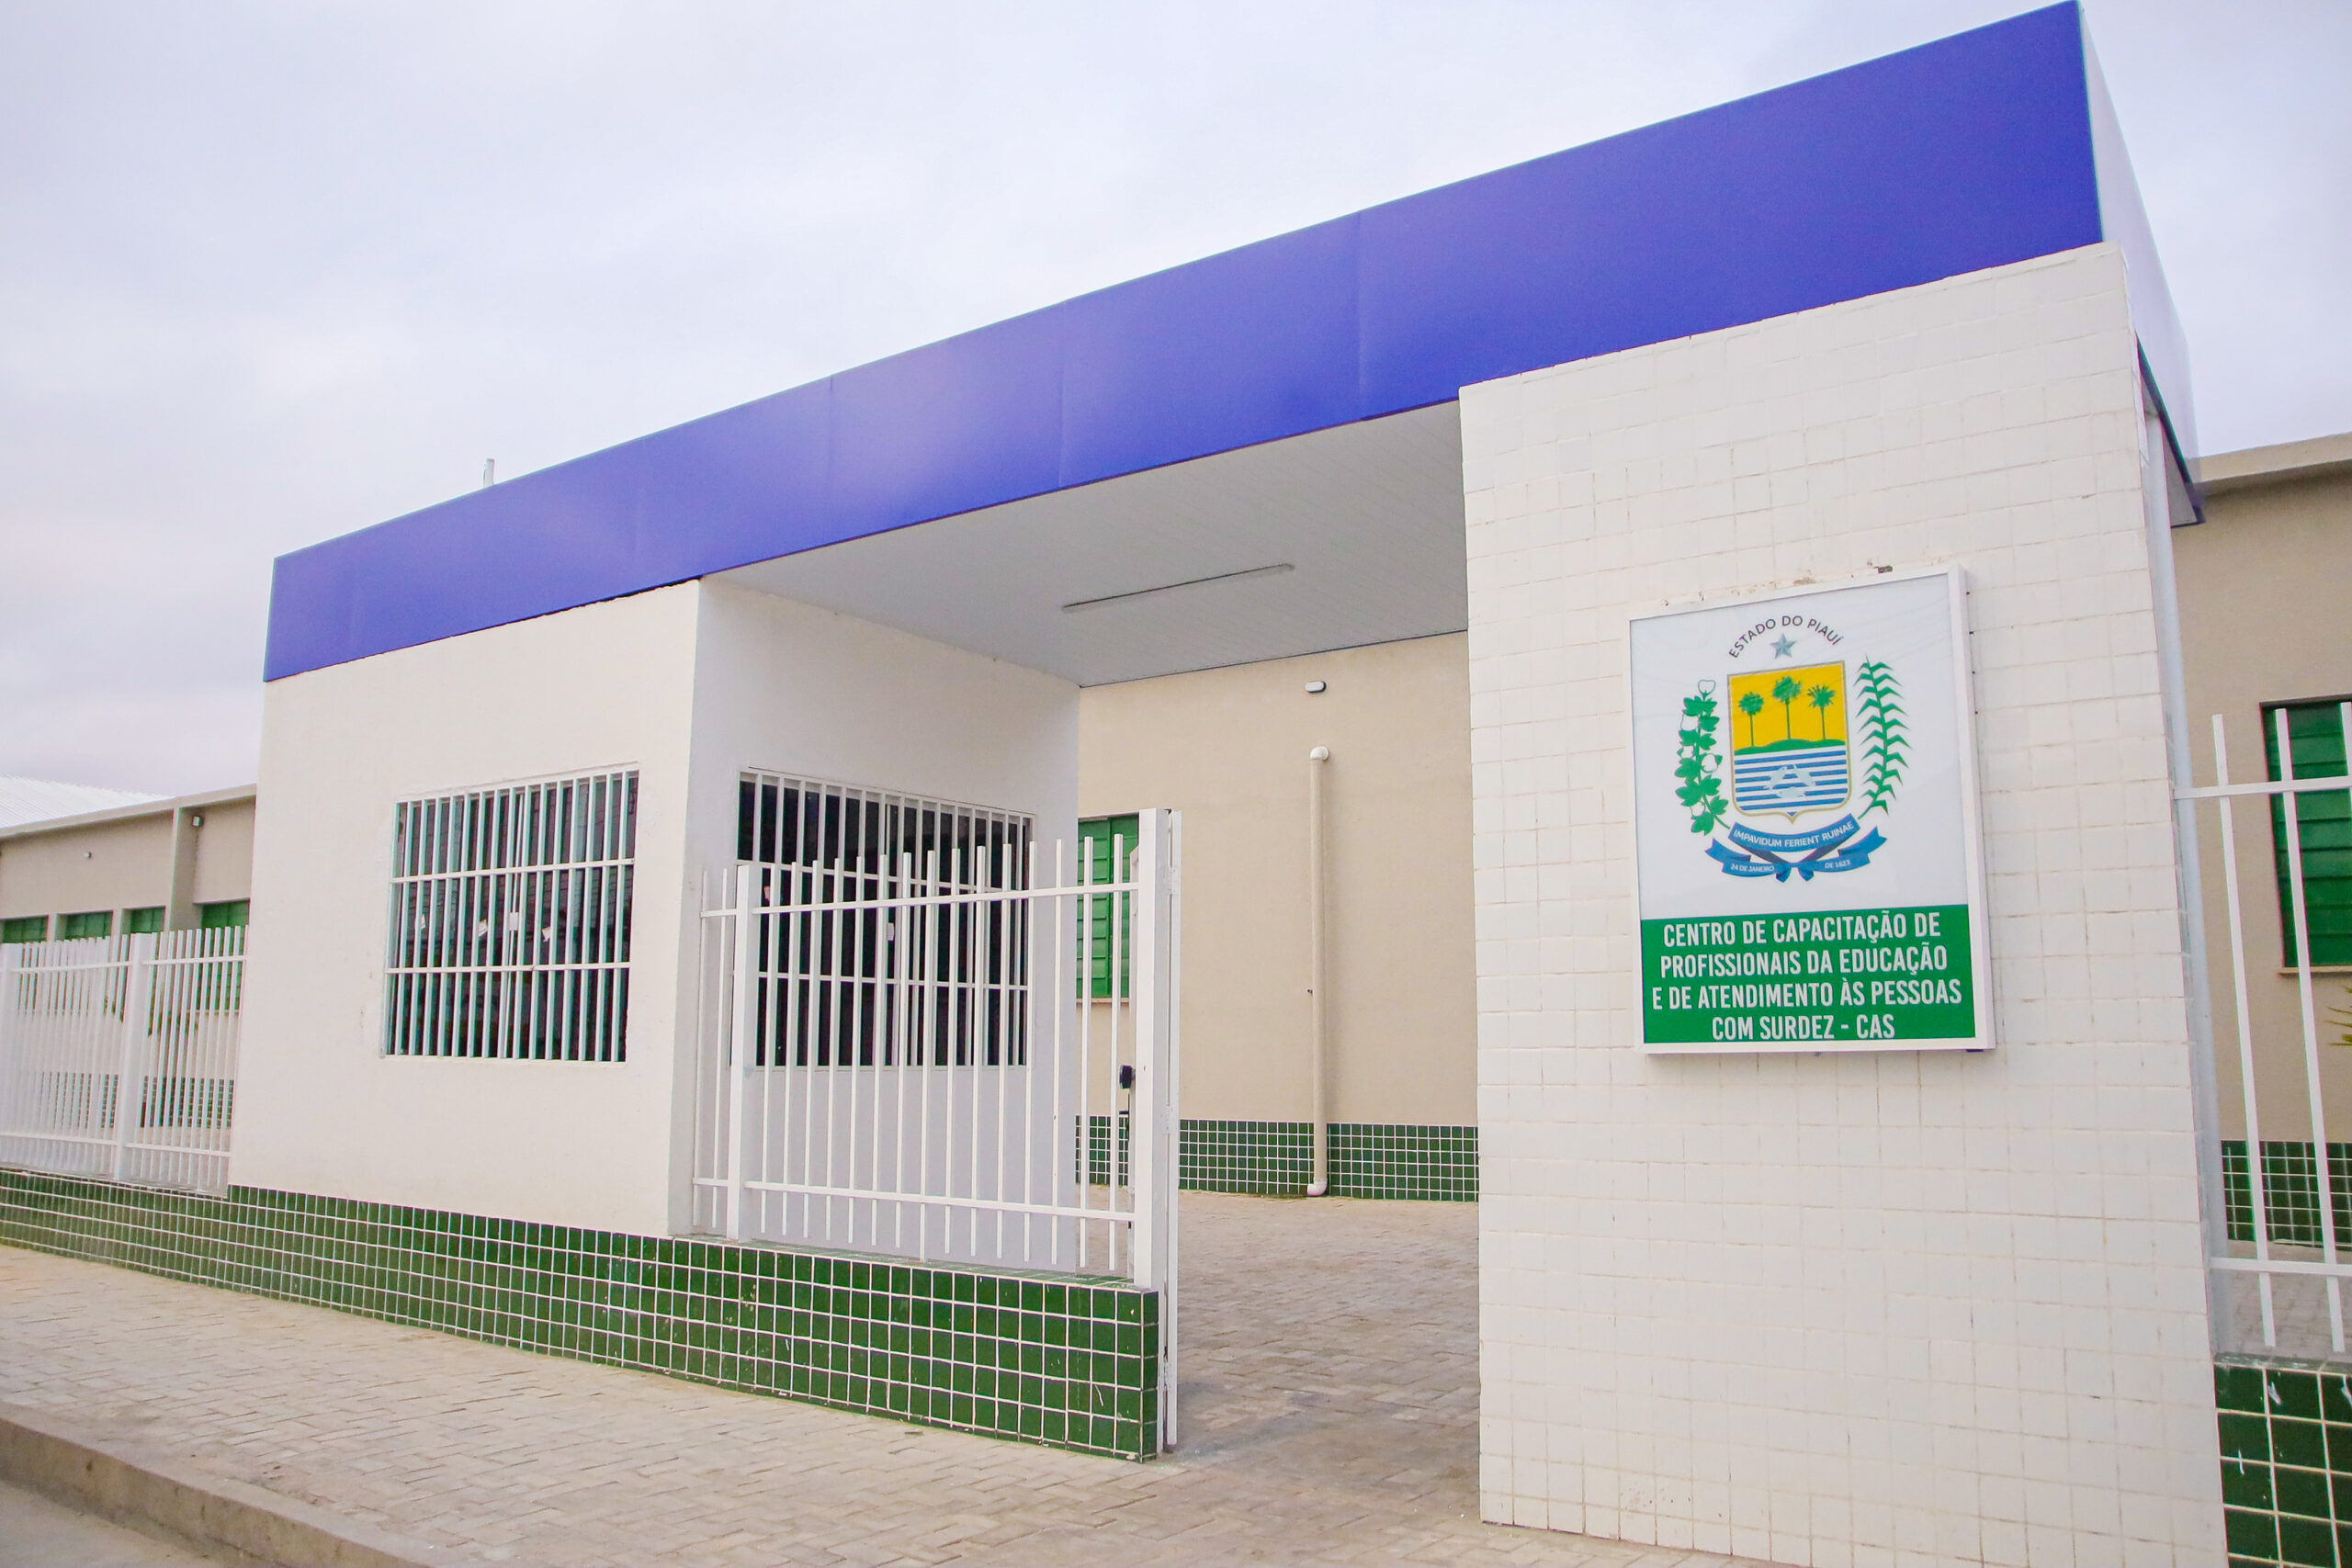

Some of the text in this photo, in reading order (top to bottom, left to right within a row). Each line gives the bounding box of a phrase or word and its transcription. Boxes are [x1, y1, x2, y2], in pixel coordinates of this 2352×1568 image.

[1728, 615, 1845, 659] ESTADO DO PIAUÍ
[1733, 821, 1854, 847] IMPAVIDUM FERIENT RUINAE
[1748, 864, 1775, 873] JANEIRO
[1663, 910, 1941, 947] CENTRO DE CAPACITAÇÃO DE
[1660, 942, 1948, 978] PROFISSIONAIS DA EDUCAÇÃO
[1652, 977, 1962, 1010] E DE ATENDIMENTO ÀS PESSOAS
[1712, 1016, 1754, 1041] COM
[1759, 1014, 1835, 1040] SURDEZ
[1856, 1013, 1895, 1039] CAS
